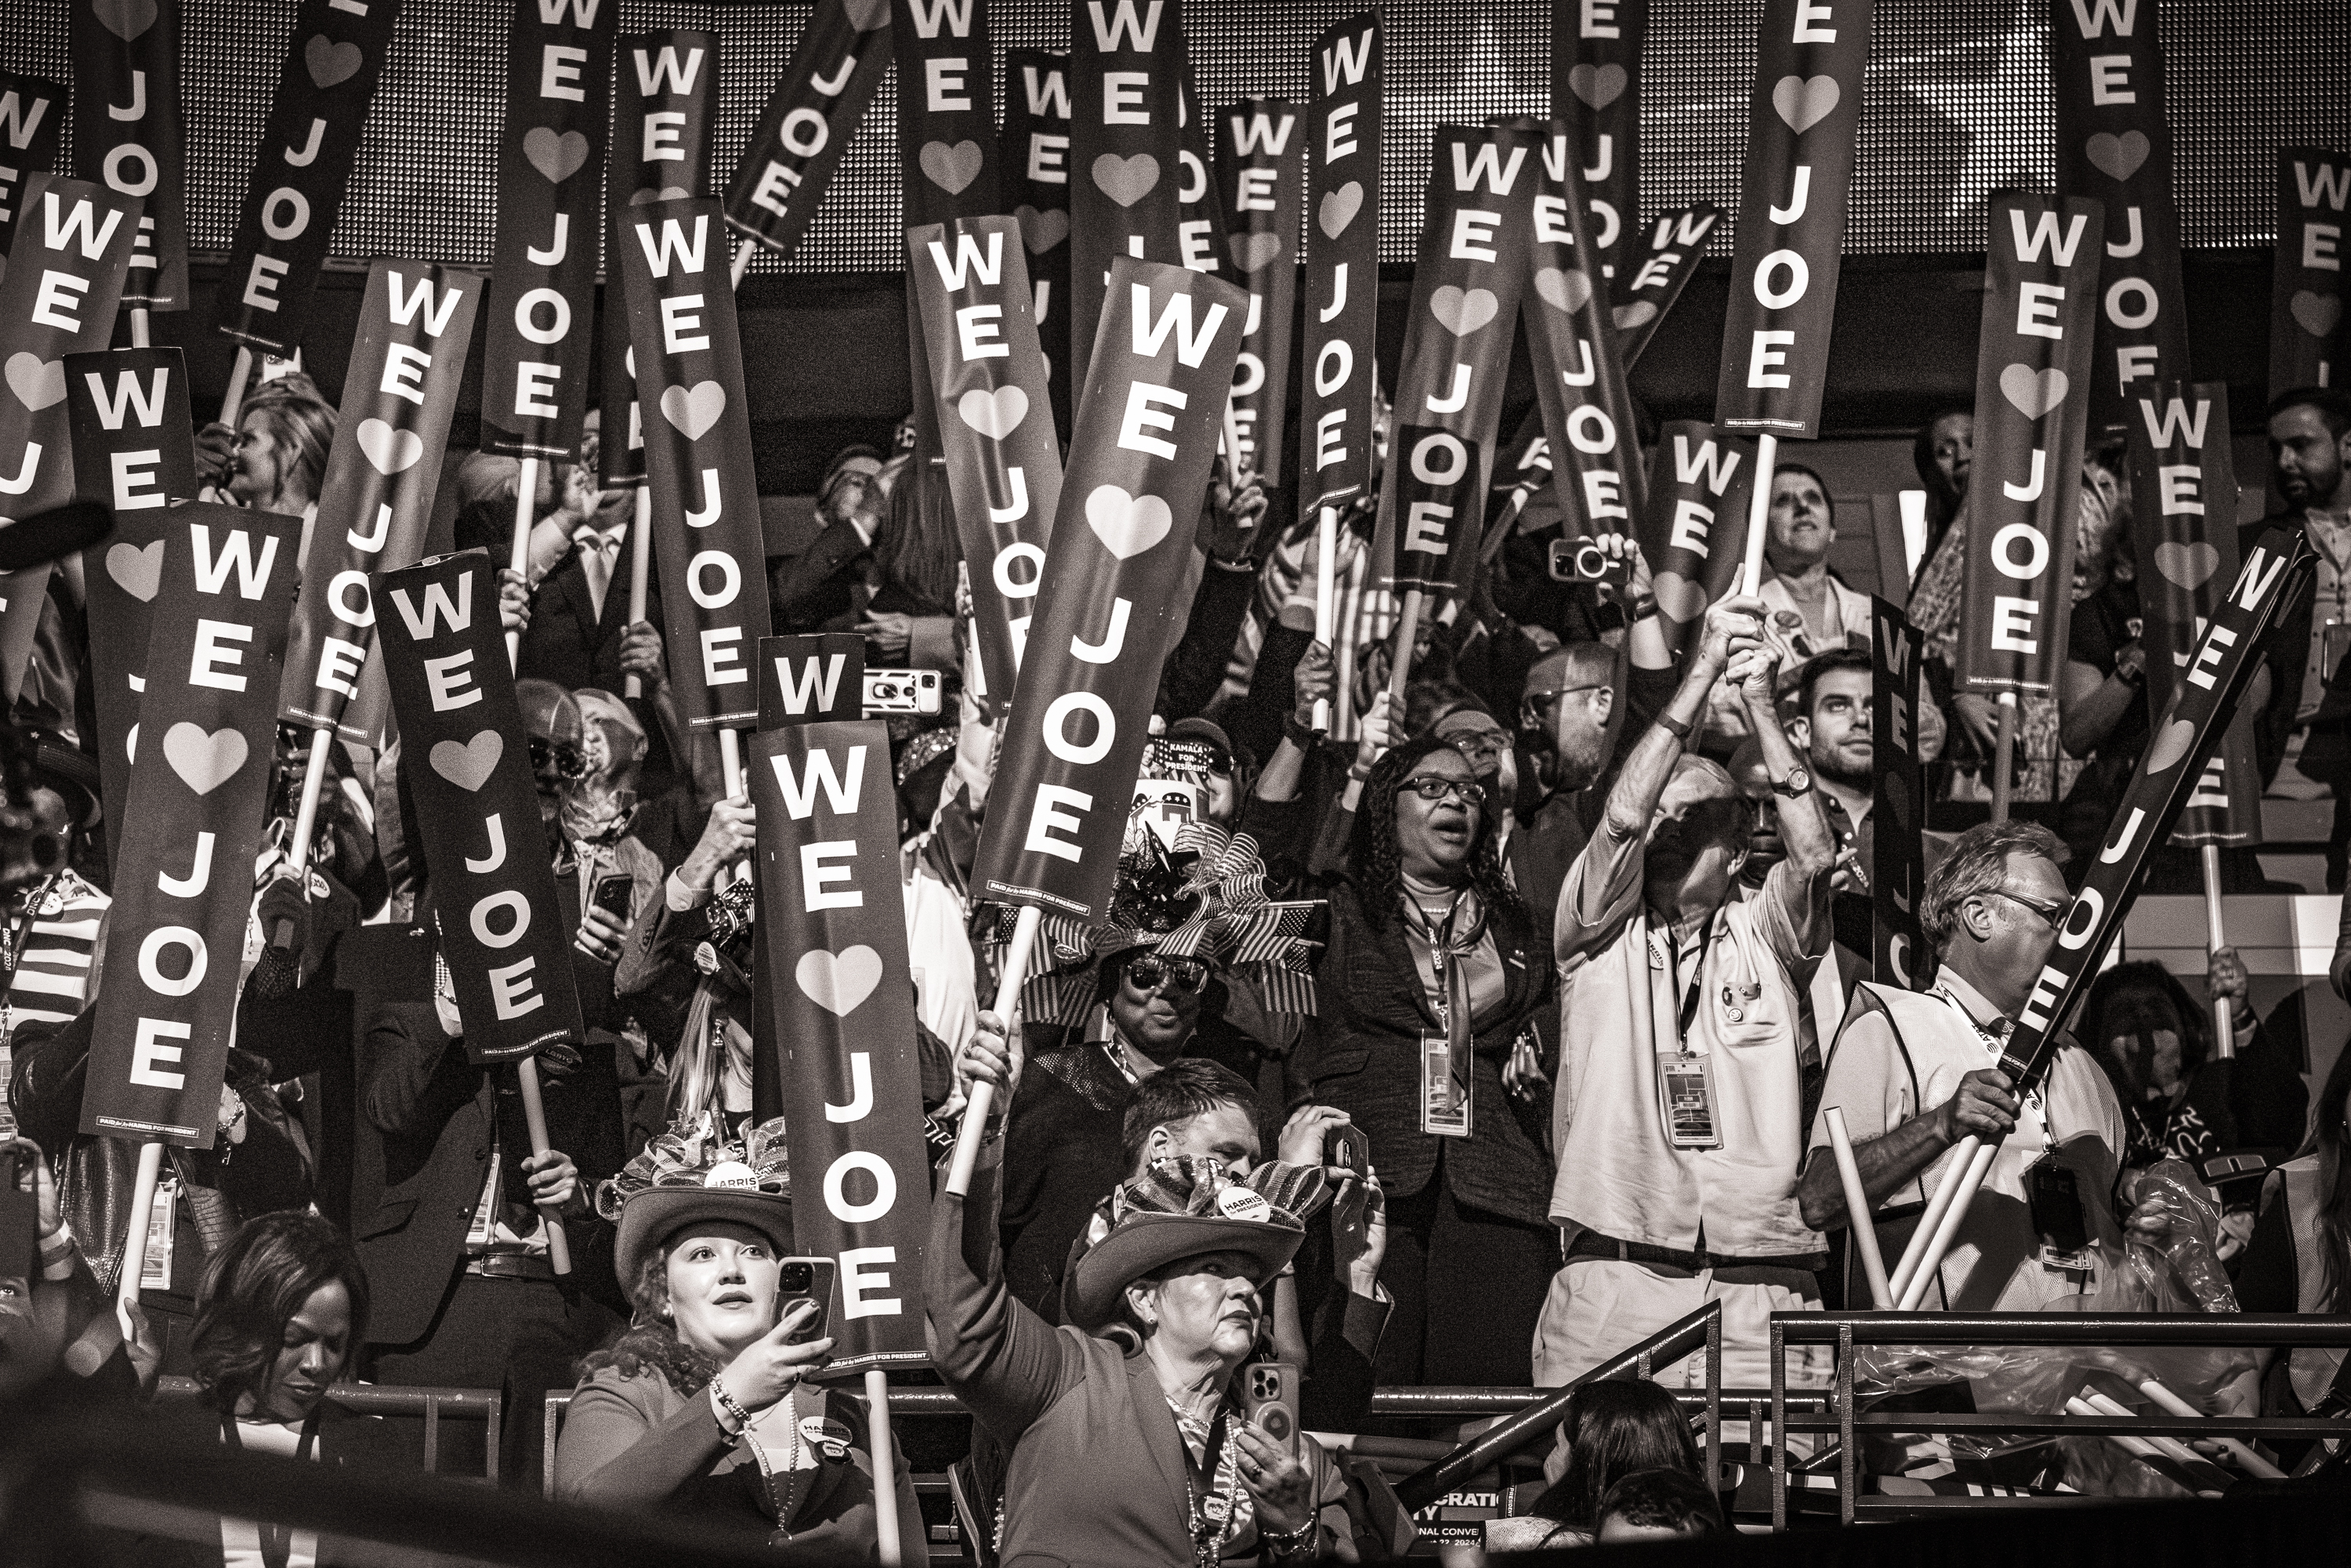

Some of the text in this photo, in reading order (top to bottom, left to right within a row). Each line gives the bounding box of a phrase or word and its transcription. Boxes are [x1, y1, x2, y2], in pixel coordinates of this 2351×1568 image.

[633, 47, 704, 161] WE
[909, 0, 972, 112] WE
[1088, 0, 1164, 125] WE
[1323, 29, 1374, 165] WE
[2071, 0, 2138, 106] WE
[752, 56, 857, 217] JOE
[1023, 65, 1070, 183] WE
[1230, 114, 1295, 212] WE
[31, 191, 124, 334] WE
[243, 118, 327, 312] JOE
[1451, 142, 1528, 263] WE
[1632, 212, 1717, 291] WE
[2294, 161, 2351, 271] WE
[514, 213, 571, 418] JOE
[929, 233, 1009, 361] WE
[1747, 165, 1811, 389] JOE
[2009, 209, 2088, 339] WE
[1315, 263, 1354, 472] JOE
[1771, 420, 1803, 429] PRESIDENT
[85, 368, 169, 510] WE
[316, 271, 462, 700] WE JOE
[635, 215, 748, 686] WE JOE
[1405, 364, 1473, 555] JOE
[1563, 339, 1628, 520] JOE
[2139, 398, 2211, 516] WE
[1670, 435, 1741, 559] WE
[1991, 449, 2049, 654] JOE
[1024, 283, 1229, 863] WE JOE
[130, 523, 280, 1091] WE JOE
[391, 570, 544, 1022] WE JOE
[1165, 762, 1207, 772] PRESIDENT
[1170, 744, 1203, 753] KAMALA
[991, 882, 1007, 891] PAID
[1020, 889, 1043, 898] HARRIS
[1042, 893, 1056, 902] FOR
[1055, 898, 1089, 913] PRESIDENT
[1648, 940, 1664, 966] ARRIS
[2019, 807, 2146, 1033] JOE
[1432, 949, 1443, 969] 2024
[538, 1030, 568, 1042] PRESIDENT
[770, 746, 902, 1320] WE JOE
[1972, 1024, 1991, 1041] AT&T
[129, 1122, 152, 1131] HARRIS
[165, 1127, 197, 1136] PRESIDENT
[711, 1177, 756, 1188] HARRIS
[1224, 1196, 1262, 1211] HARRIS
[1237, 1202, 1265, 1212] PRESIDENT
[854, 1355, 877, 1363] HARRIS
